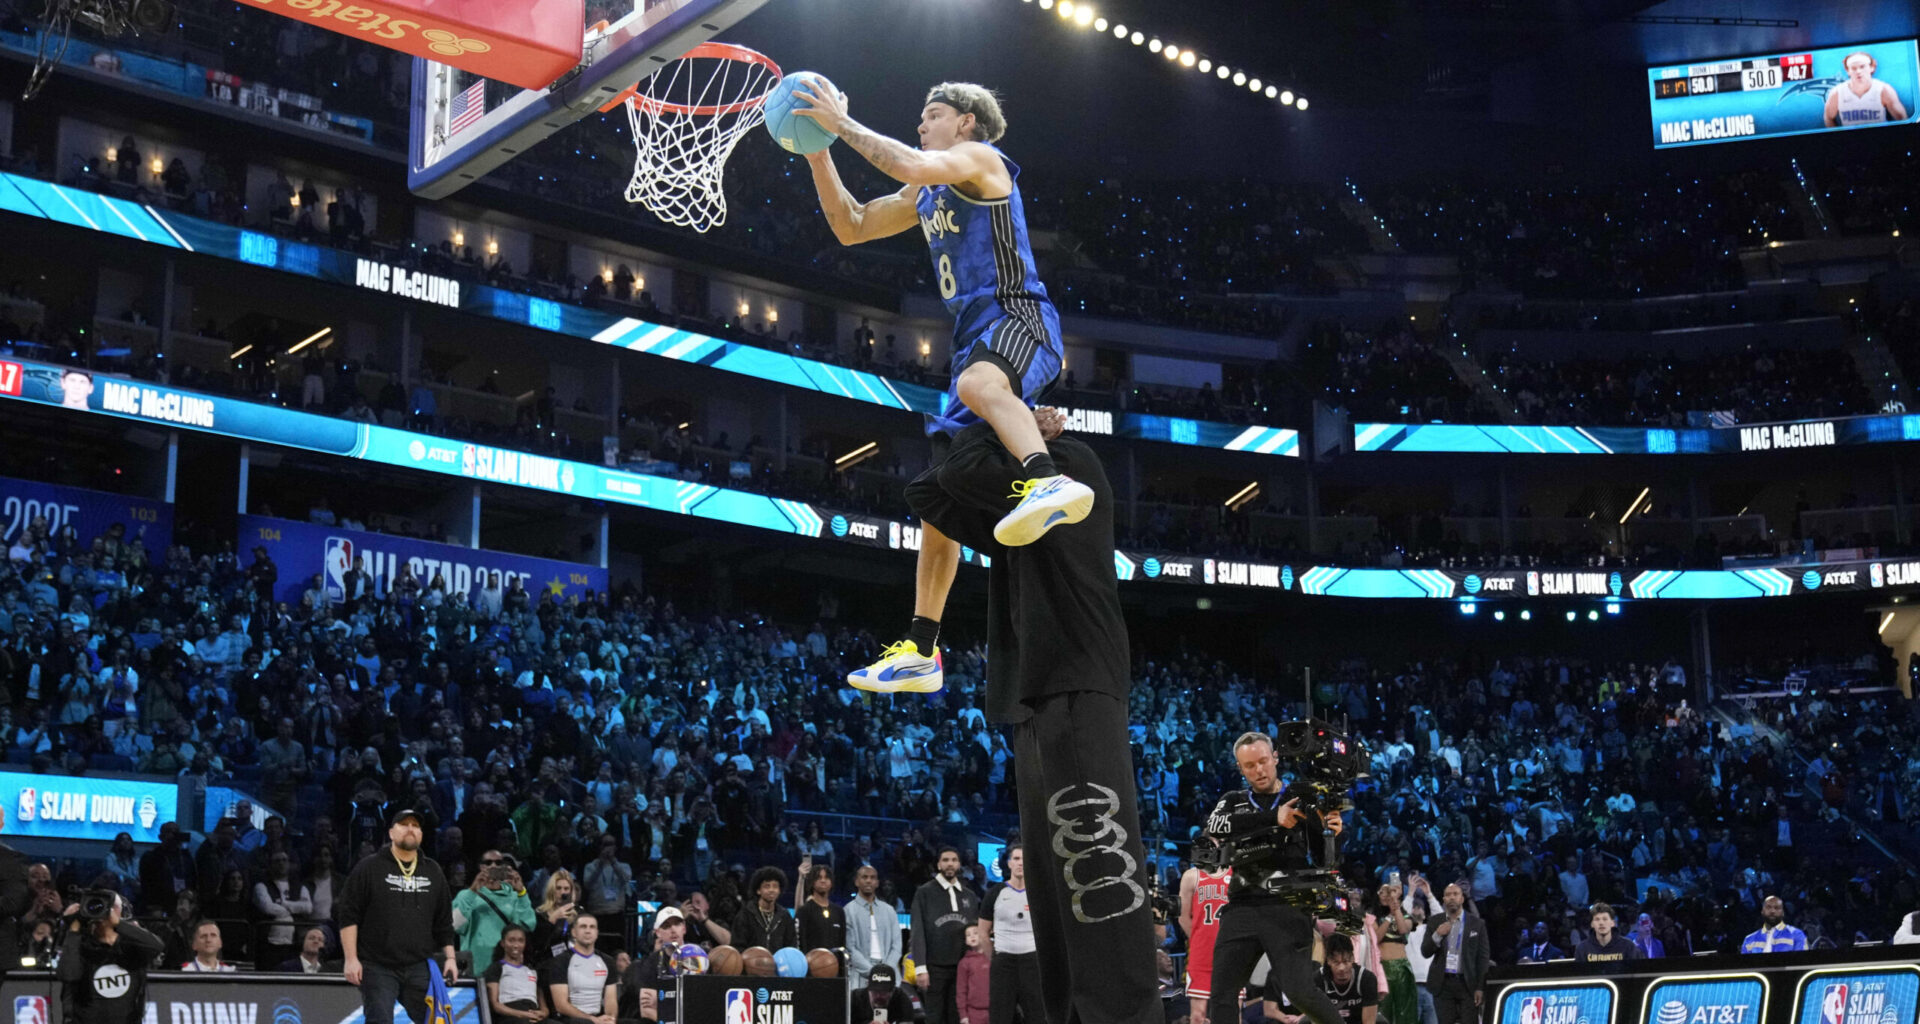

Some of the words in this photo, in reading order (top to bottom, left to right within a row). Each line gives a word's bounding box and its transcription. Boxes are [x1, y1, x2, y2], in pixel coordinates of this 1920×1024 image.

[1749, 69, 1776, 89] 50.0
[1787, 64, 1807, 81] 49.7
[1691, 76, 1714, 94] 50.0
[1660, 121, 1691, 144] MAC
[1692, 114, 1756, 140] McCLUNG
[356, 258, 391, 292] MAC
[392, 266, 460, 308] McCLUNG
[938, 254, 957, 300] 8
[0, 363, 19, 393] .7
[103, 382, 141, 415] MAC
[141, 388, 214, 428] McCLUNG
[1740, 426, 1770, 451] MAC
[1772, 421, 1835, 449] McCLUNG
[427, 447, 458, 463] AT&T
[476, 446, 517, 483] SLAM
[519, 453, 560, 491] DUNK
[4, 496, 80, 541] 2025
[129, 506, 157, 523] 103
[258, 527, 281, 542] 104
[849, 521, 879, 539] AT&T
[902, 525, 923, 551] SLA
[569, 573, 588, 586] 104
[1162, 562, 1193, 577] AT&T
[1217, 561, 1248, 586] SLAM
[1249, 564, 1280, 588] DUNK
[1483, 578, 1516, 591] AT&T
[1541, 573, 1574, 595] SLAM
[1575, 573, 1608, 595] DUNK
[1823, 571, 1858, 586] AT&T
[1886, 562, 1920, 585] SLAM
[40, 790, 87, 822] SLAM
[90, 794, 136, 825] DUNK
[1198, 883, 1230, 905] BULL
[1203, 902, 1226, 926] 14
[95, 974, 130, 990] TNT
[1863, 982, 1886, 991] AT&T
[770, 990, 794, 1001] AT&T
[1558, 995, 1579, 1004] AT&T
[1849, 992, 1885, 1015] SLAM
[757, 1004, 794, 1024] SLAM
[1545, 1004, 1578, 1024] SLAM
[1691, 1004, 1749, 1024] AT&T
